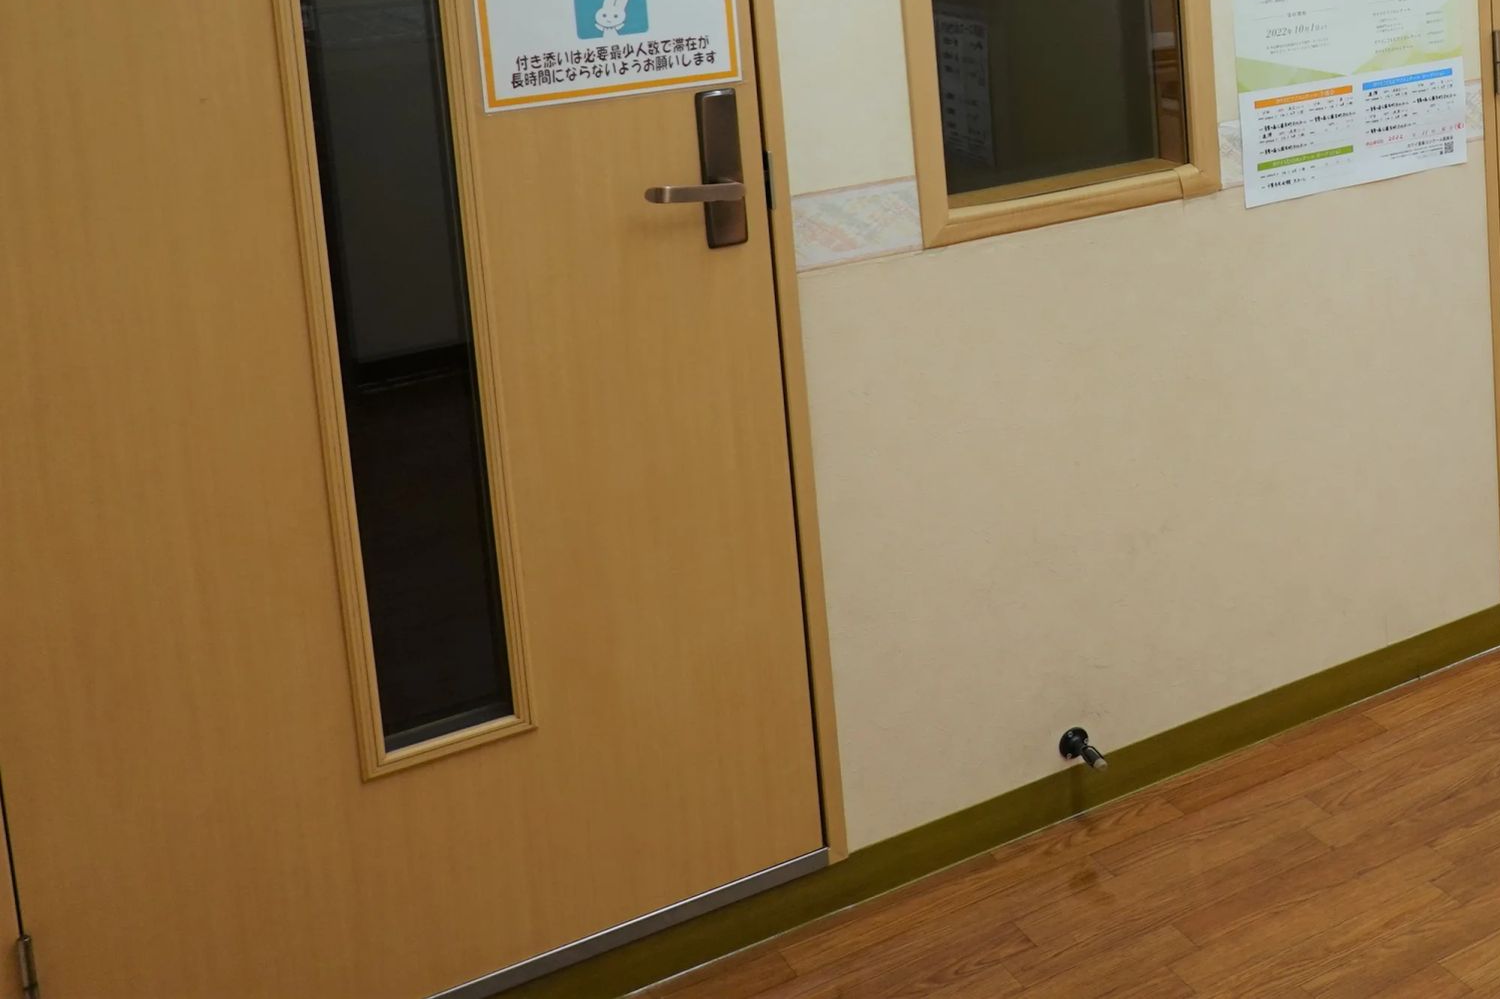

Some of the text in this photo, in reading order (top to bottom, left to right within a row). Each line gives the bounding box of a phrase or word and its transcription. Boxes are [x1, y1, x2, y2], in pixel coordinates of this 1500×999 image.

[511, 50, 716, 89] 長時間にならないようお願いします
